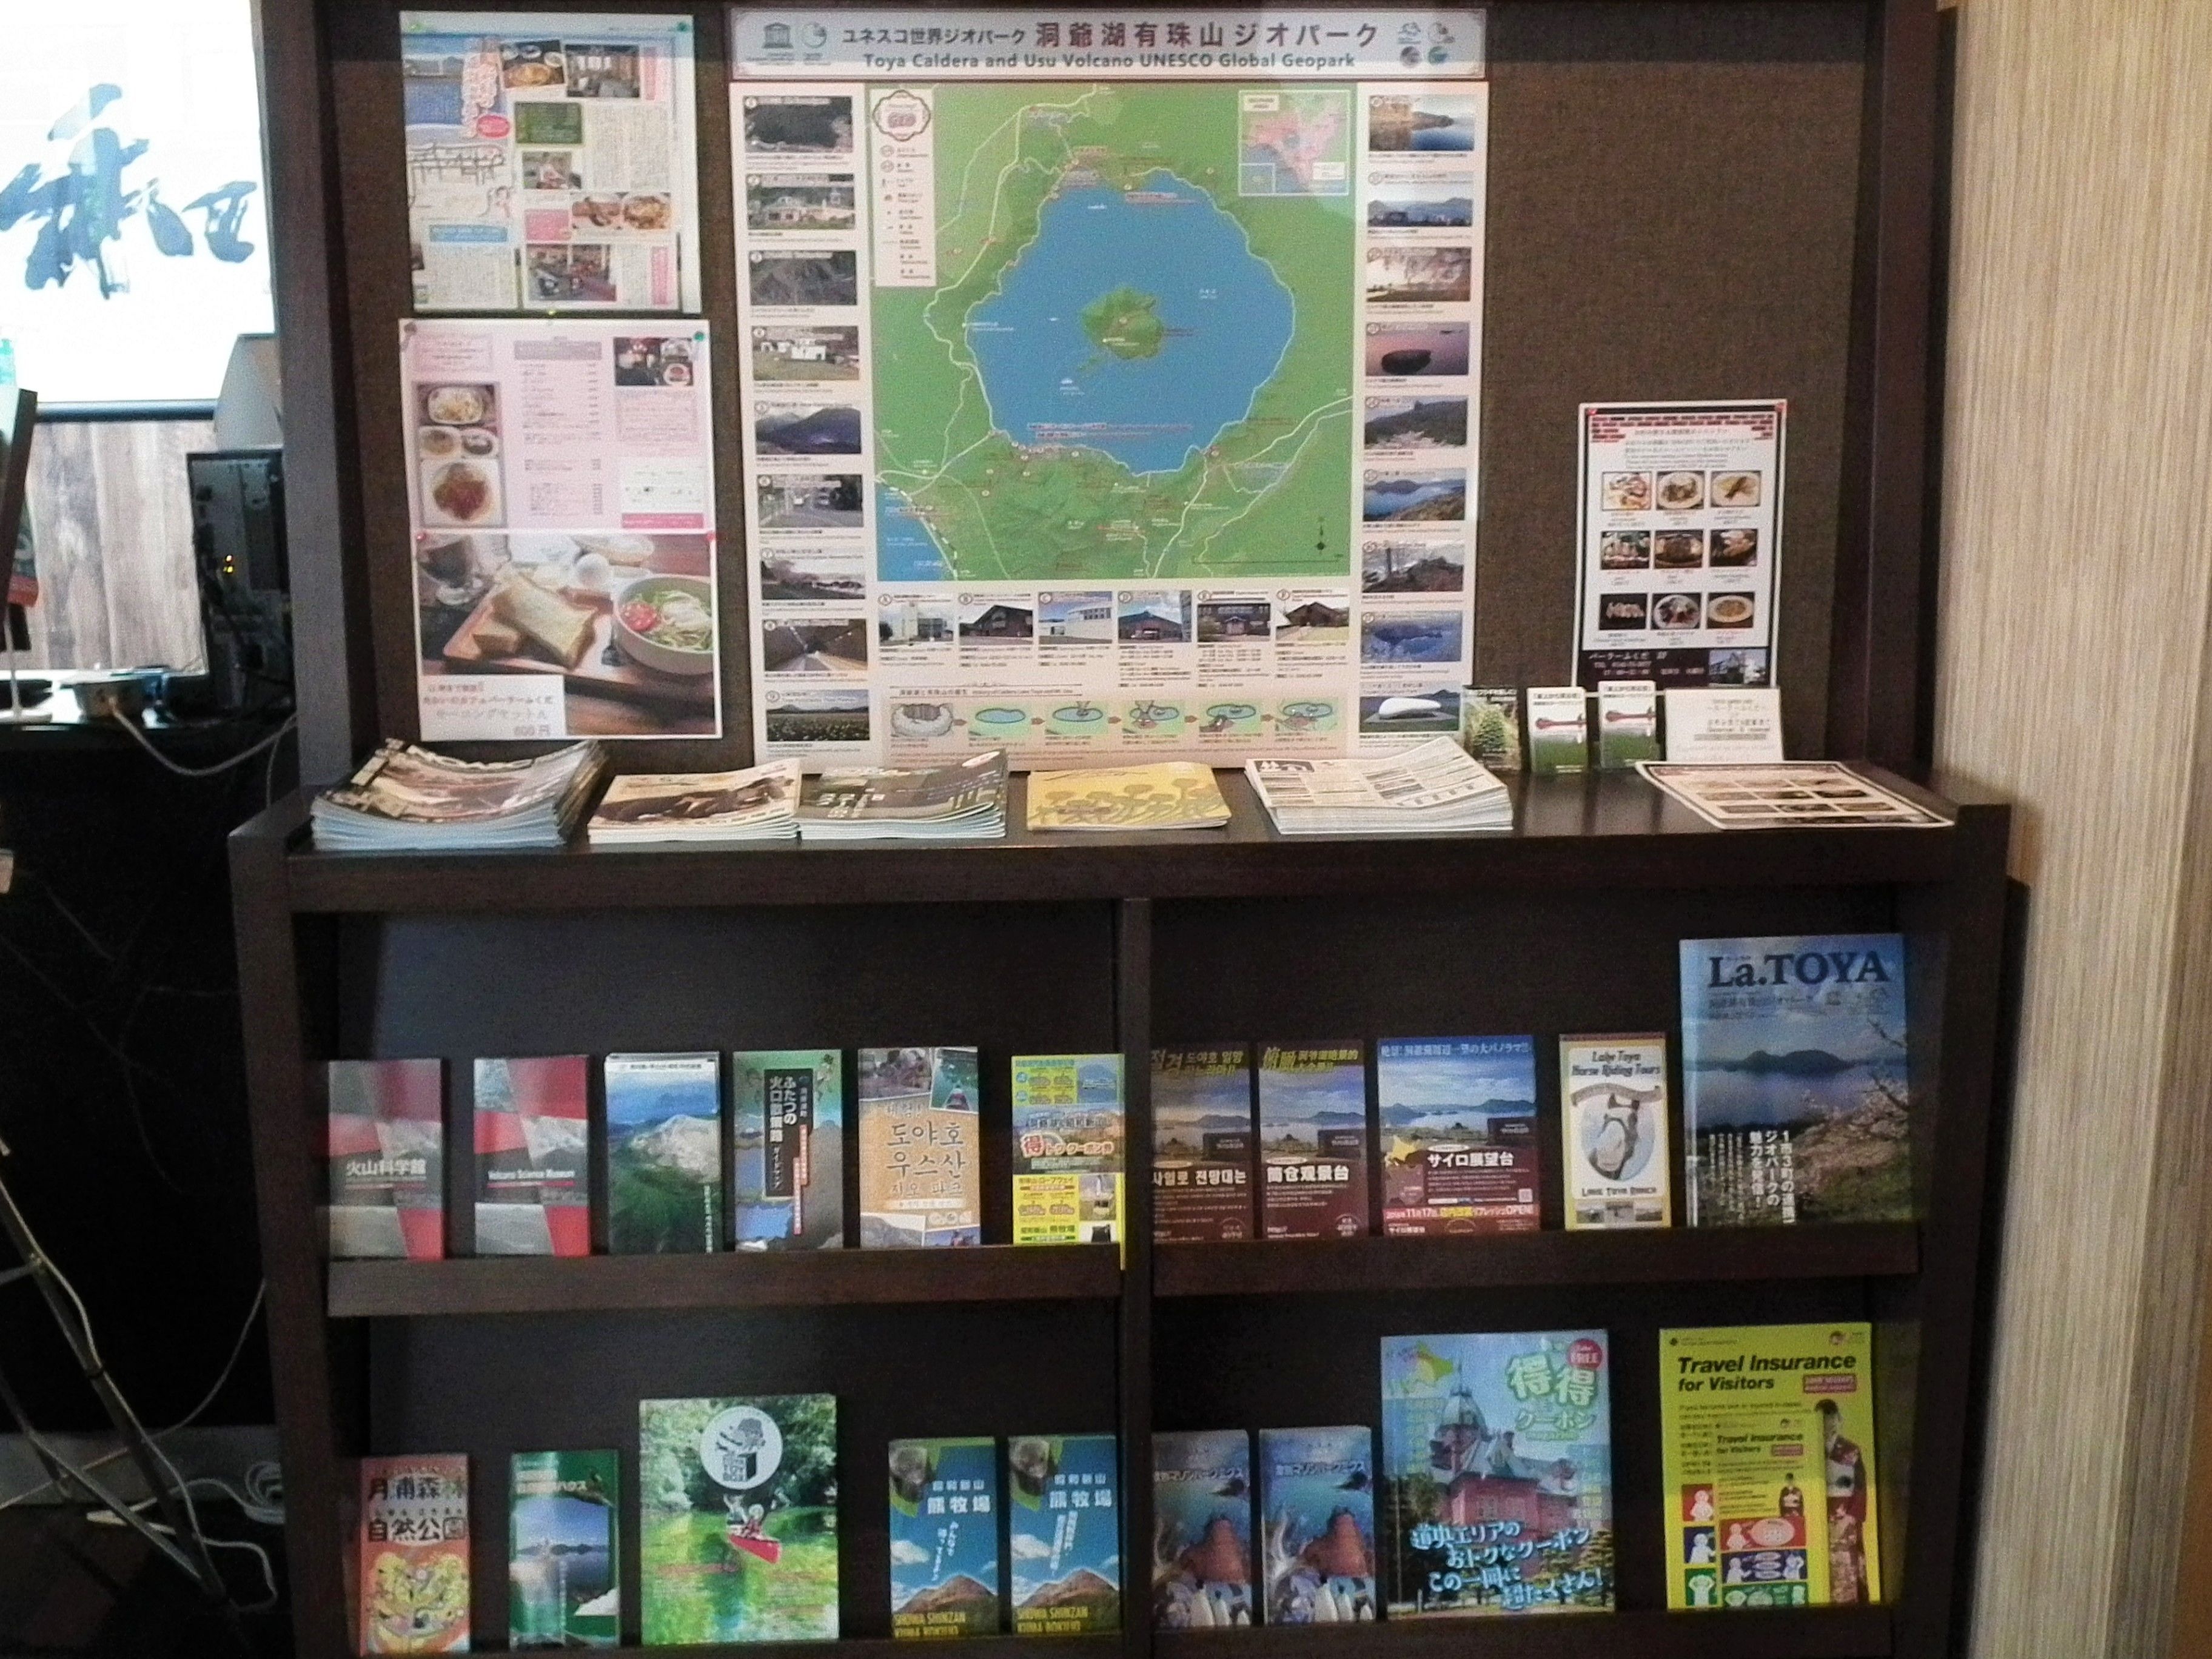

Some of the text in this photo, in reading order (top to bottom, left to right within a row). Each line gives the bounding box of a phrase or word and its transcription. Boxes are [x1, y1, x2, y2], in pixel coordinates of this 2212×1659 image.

[842, 21, 1378, 49] ユネスコ世界ジオパーク 洞爺湖有珠山ジオパーク
[865, 52, 1355, 72] Toya Caldera and Usu Volcano UNESCO Global Geopark
[1708, 950, 1891, 988] La.TOYA
[1617, 1050, 1641, 1063] Toya
[1572, 1062, 1661, 1078] Horse Riding Tours
[783, 1076, 798, 1125] ふたつの
[887, 1121, 964, 1146] 도야호
[346, 1159, 426, 1176] 火山科学館
[886, 1150, 966, 1179] 우스산
[1427, 1152, 1515, 1168] サイロ展望台
[1765, 1130, 1780, 1206] ジオパークの
[1677, 1353, 1856, 1374] Travel Insurance
[1677, 1376, 1775, 1392] for Visitors
[1516, 1407, 1597, 1431] クーポン
[367, 1517, 466, 1542] 自然公園
